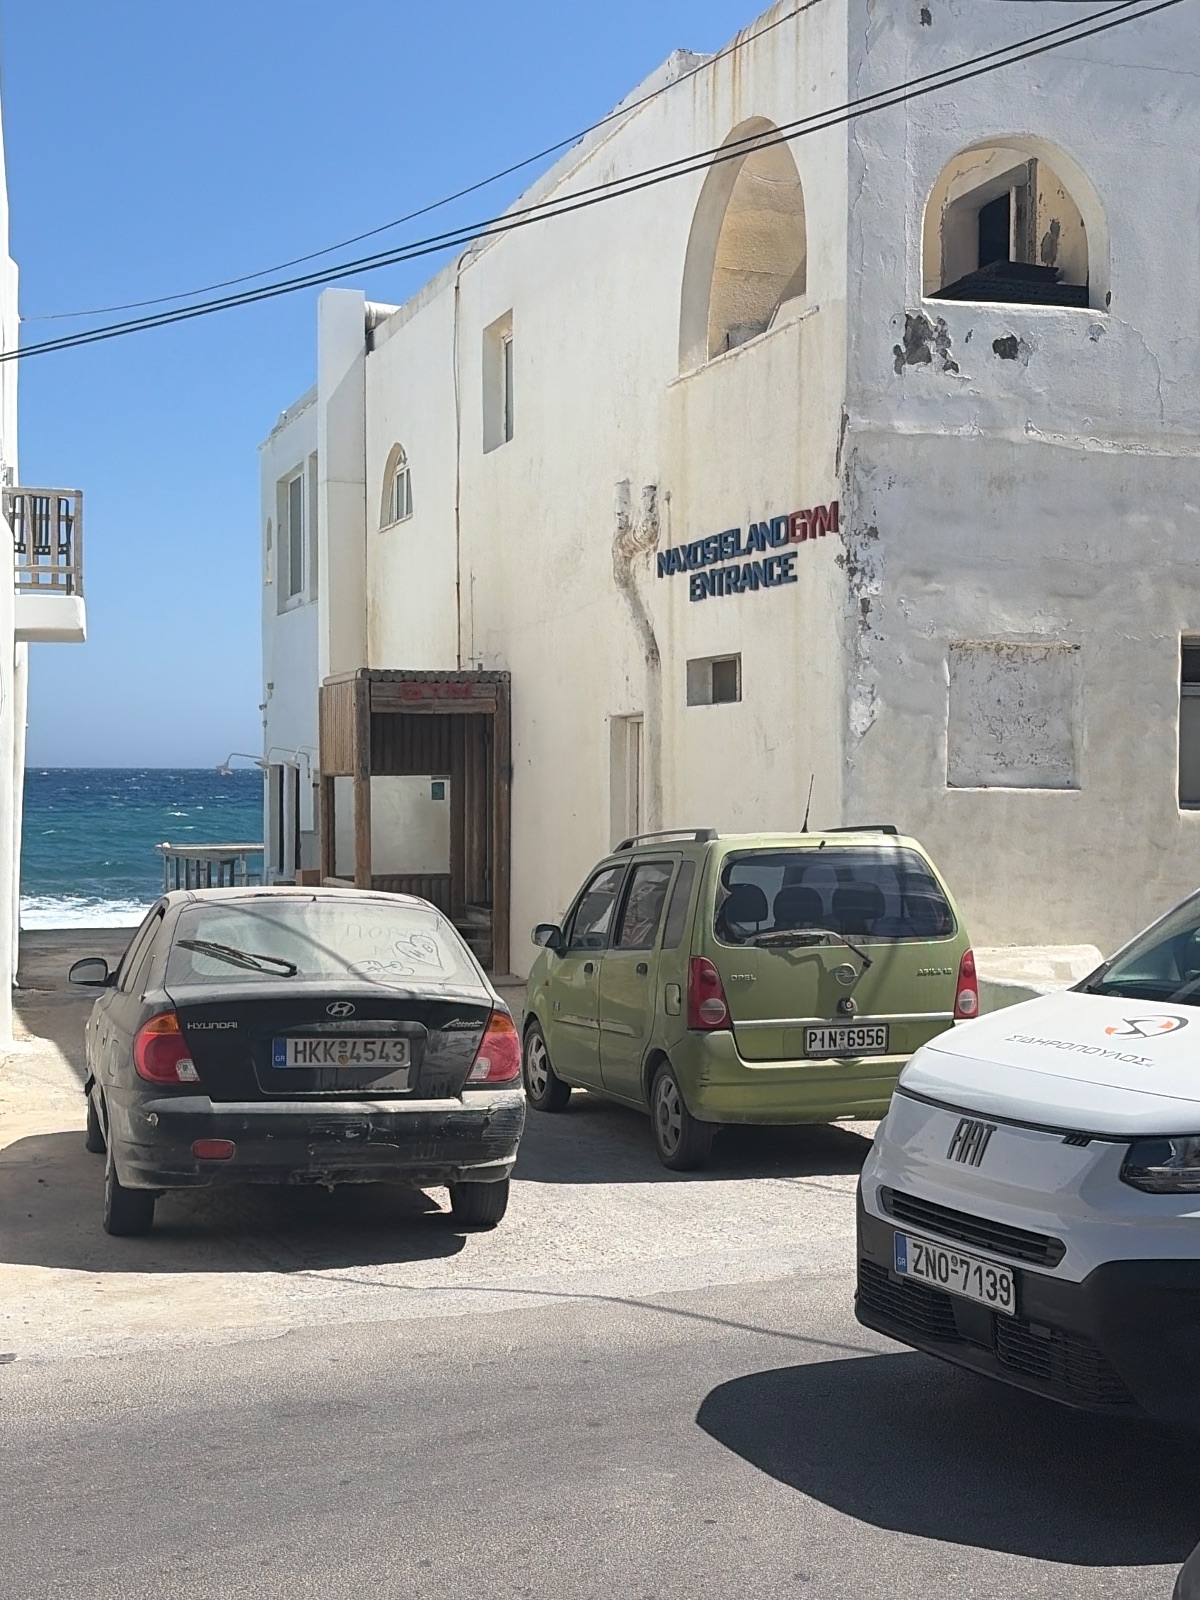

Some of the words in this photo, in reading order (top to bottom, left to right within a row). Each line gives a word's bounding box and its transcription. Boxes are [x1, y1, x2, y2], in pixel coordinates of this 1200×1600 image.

[689, 551, 798, 602] ENTRANCE
[400, 681, 473, 700] GYM
[730, 973, 757, 981] OPEL
[187, 1021, 238, 1030] HYUNDAI
[1005, 1034, 1153, 1066] ΣΙΔΗΡΟΠΟΥΛΟΣ
[946, 1118, 998, 1168] FIAT
[897, 1256, 906, 1267] GR
